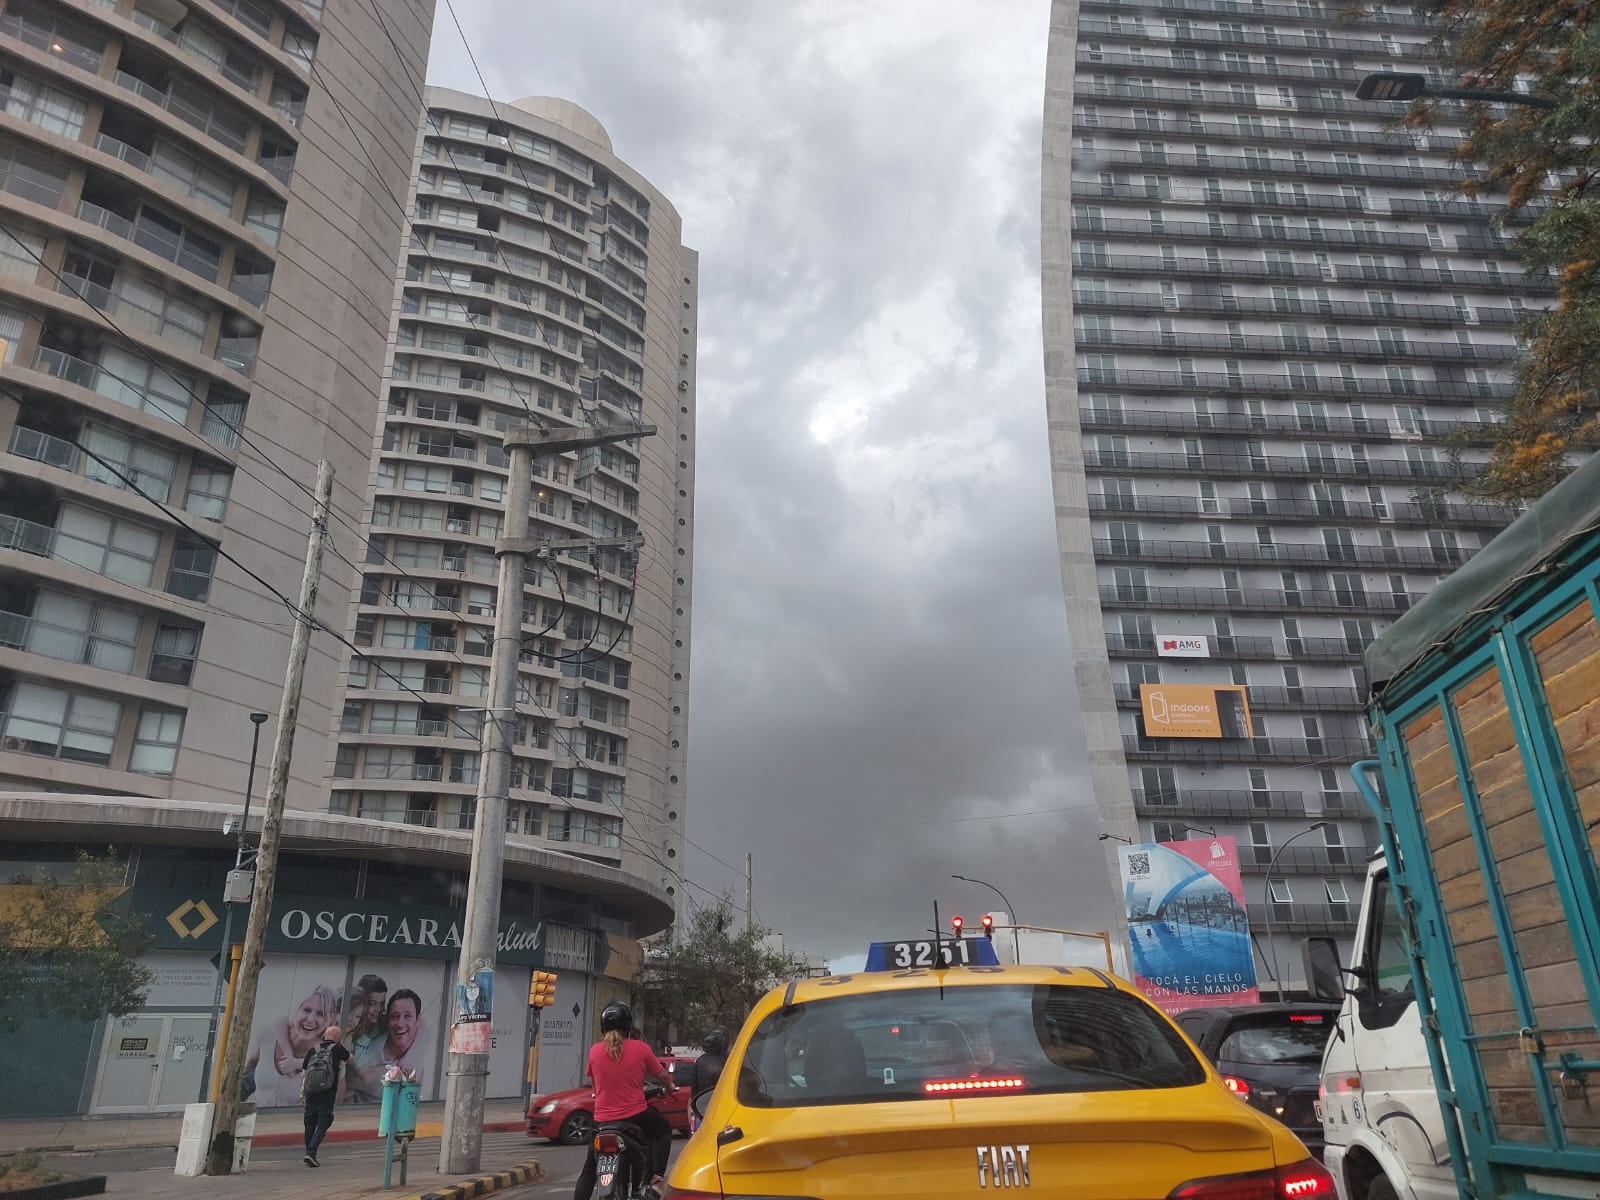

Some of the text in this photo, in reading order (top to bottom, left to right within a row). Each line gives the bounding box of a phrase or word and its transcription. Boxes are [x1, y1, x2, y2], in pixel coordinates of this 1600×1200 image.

[1179, 640, 1201, 649] AMG
[280, 909, 542, 951] OSCEARA alud
[1184, 975, 1200, 984] EL
[1205, 973, 1242, 983] CIELO
[1145, 983, 1249, 997] CON LAS MANOS
[173, 1036, 194, 1044] BIEN
[1353, 1100, 1361, 1120] 6
[977, 1144, 1030, 1188] FIAT
